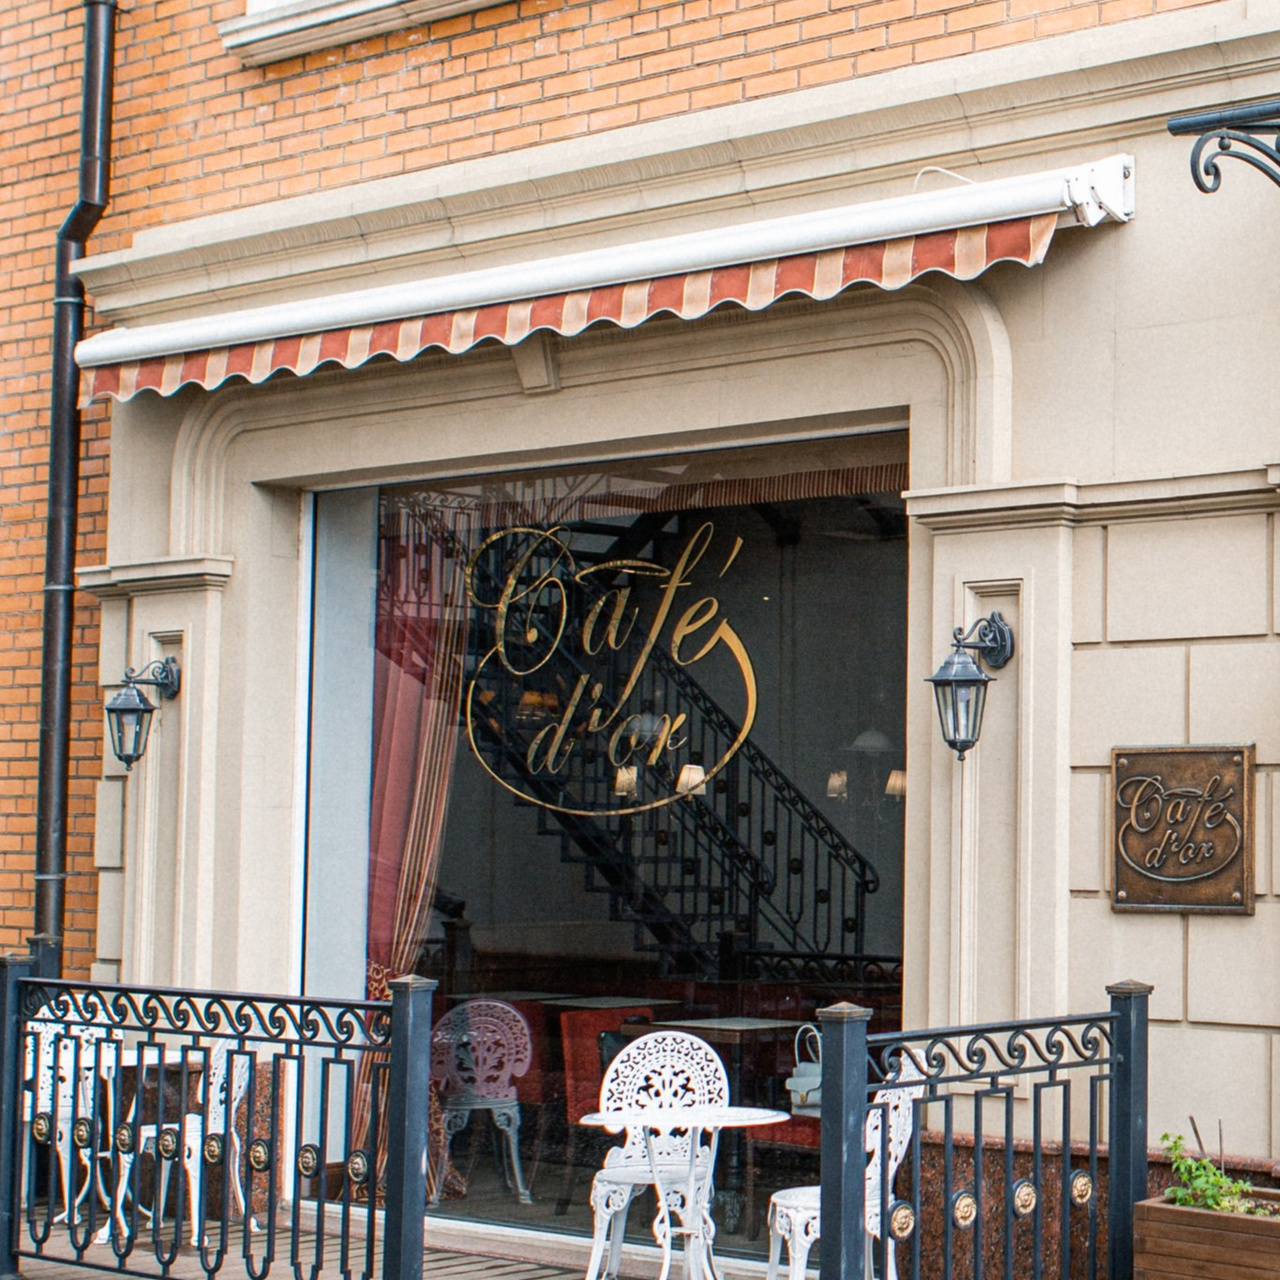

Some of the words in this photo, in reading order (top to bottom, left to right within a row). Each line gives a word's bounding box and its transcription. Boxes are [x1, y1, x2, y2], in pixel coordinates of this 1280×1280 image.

[465, 521, 744, 732] Café
[526, 673, 688, 775] d'or
[1117, 774, 1234, 852] Café
[1145, 829, 1214, 868] d'or
